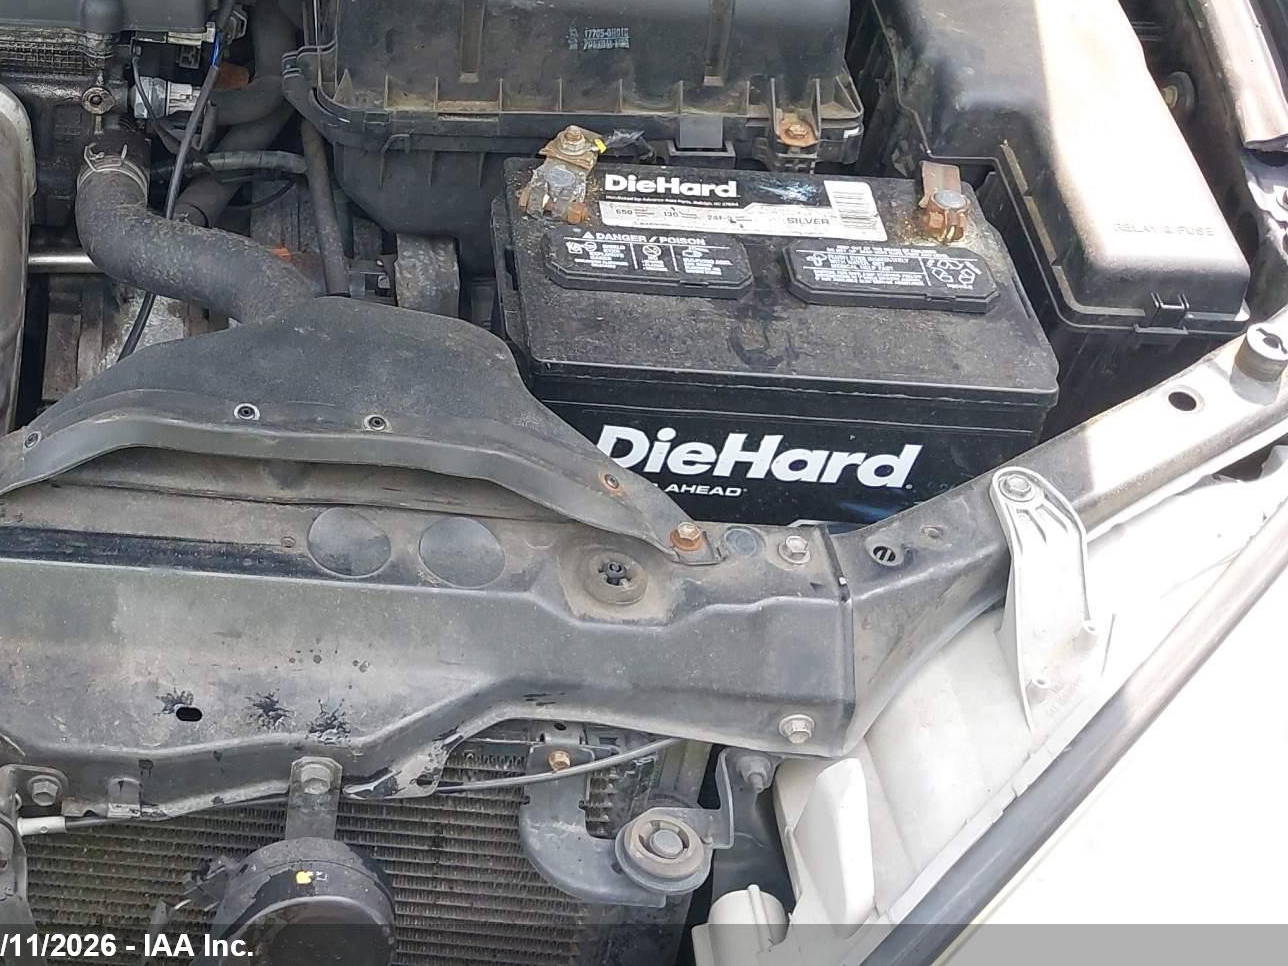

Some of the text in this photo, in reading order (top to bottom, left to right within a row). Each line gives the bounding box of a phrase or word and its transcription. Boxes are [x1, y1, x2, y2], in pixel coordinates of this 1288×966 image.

[605, 174, 737, 198] DieHard
[786, 217, 830, 225] SILVER
[595, 233, 647, 243] DANGER
[659, 236, 706, 245] POISON
[596, 424, 923, 489] DieHard
[664, 483, 742, 497] AHEAD
